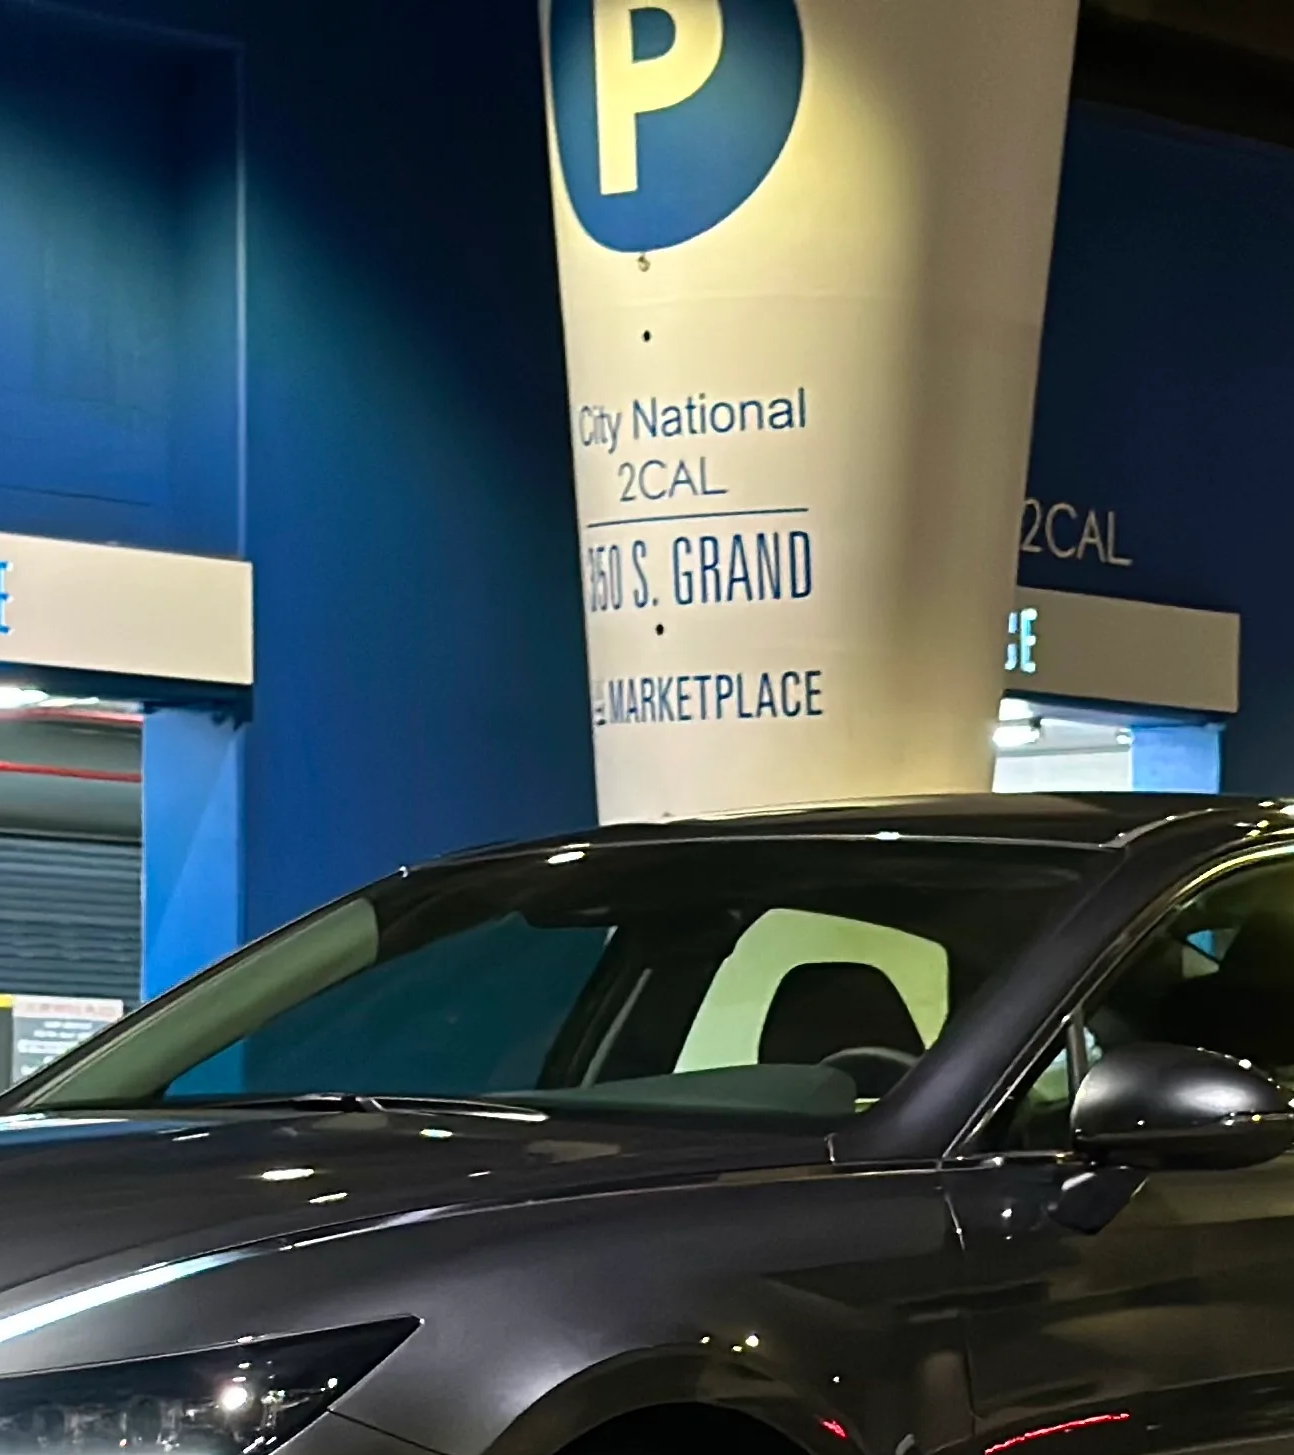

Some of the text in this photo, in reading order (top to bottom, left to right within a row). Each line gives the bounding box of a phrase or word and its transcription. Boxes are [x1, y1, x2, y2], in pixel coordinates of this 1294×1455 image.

[594, 0, 724, 195] P
[579, 386, 806, 454] City National
[618, 456, 729, 502] 2CAL
[1020, 498, 1133, 566] 2CAL
[632, 540, 659, 608] S.
[673, 530, 812, 605] GRAND
[608, 670, 823, 724] MARKETPLACE
